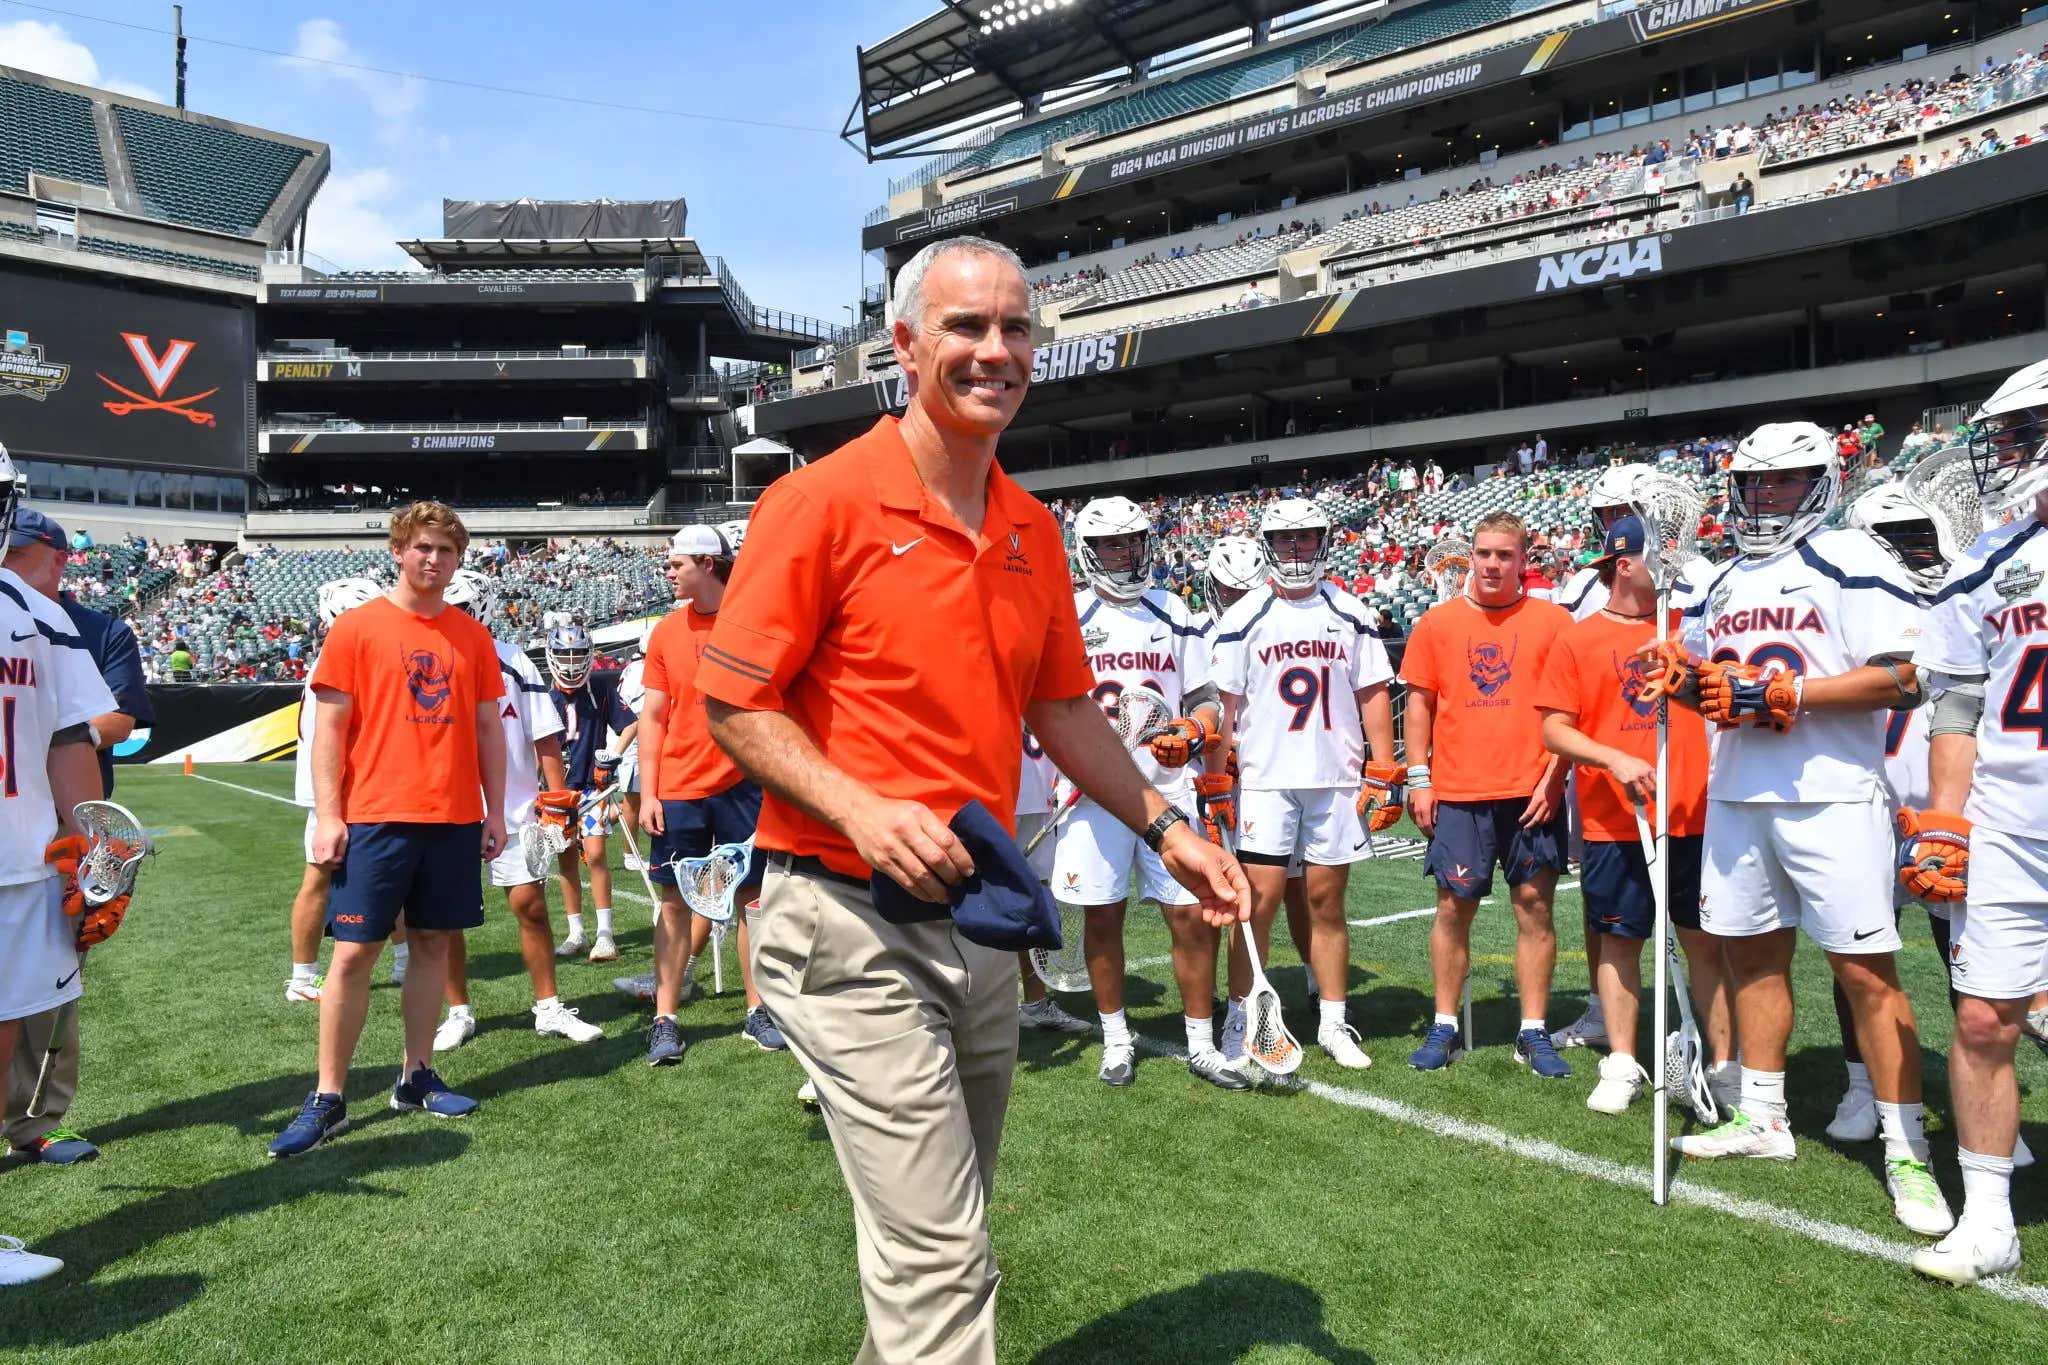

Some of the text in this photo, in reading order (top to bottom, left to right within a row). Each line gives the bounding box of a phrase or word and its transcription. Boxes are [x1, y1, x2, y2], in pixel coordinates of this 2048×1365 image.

[1110, 63, 1482, 178] 2024 NCAA DIVISION I MEN'S LACROSSE CHAMPIONSHIP
[931, 203, 979, 229] LACROSSE
[1536, 236, 1663, 293] NCAA
[275, 363, 333, 378] PENALTY
[411, 435, 495, 449] 3 CHAMPIONS
[1257, 639, 1349, 667] VIRGINIA
[1278, 665, 1332, 733] 91
[1464, 697, 1511, 708] LACROSSE
[564, 702, 580, 742] 1
